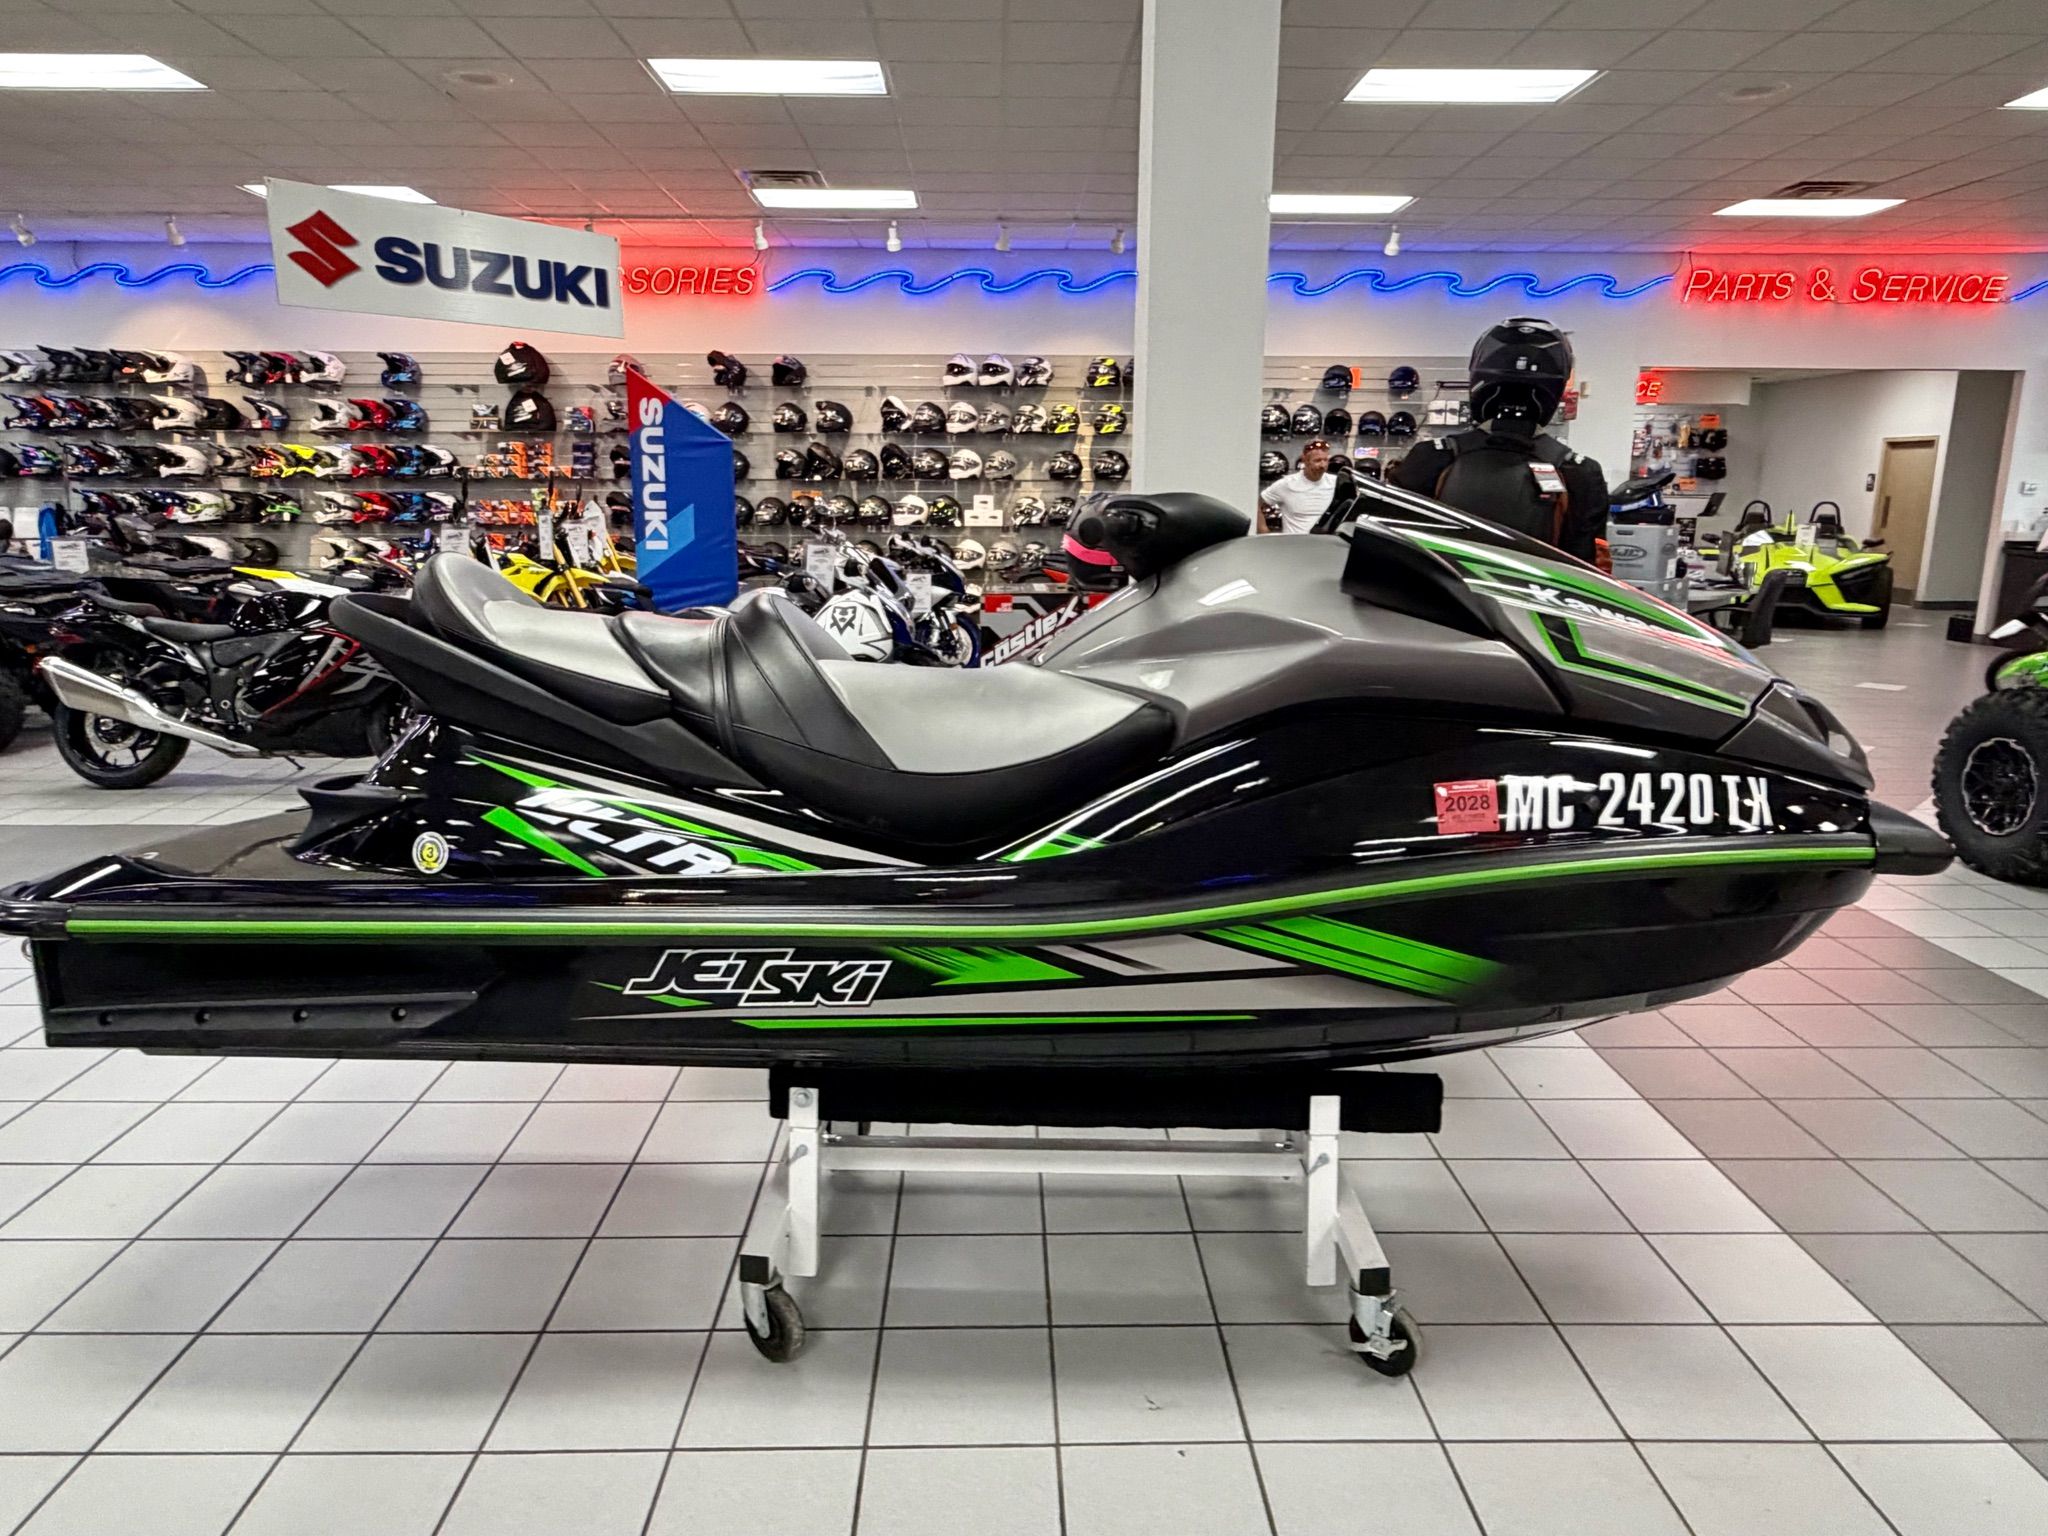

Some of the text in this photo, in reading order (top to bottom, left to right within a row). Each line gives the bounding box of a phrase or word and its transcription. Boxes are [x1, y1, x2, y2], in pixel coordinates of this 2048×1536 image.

[374, 236, 611, 309] SUZUKI
[1684, 268, 2009, 302] PARTS & SERVICE
[639, 397, 669, 551] SUZUKI
[1444, 794, 1490, 812] 2028
[1505, 775, 1575, 832] MC
[1598, 772, 1714, 825] 2420
